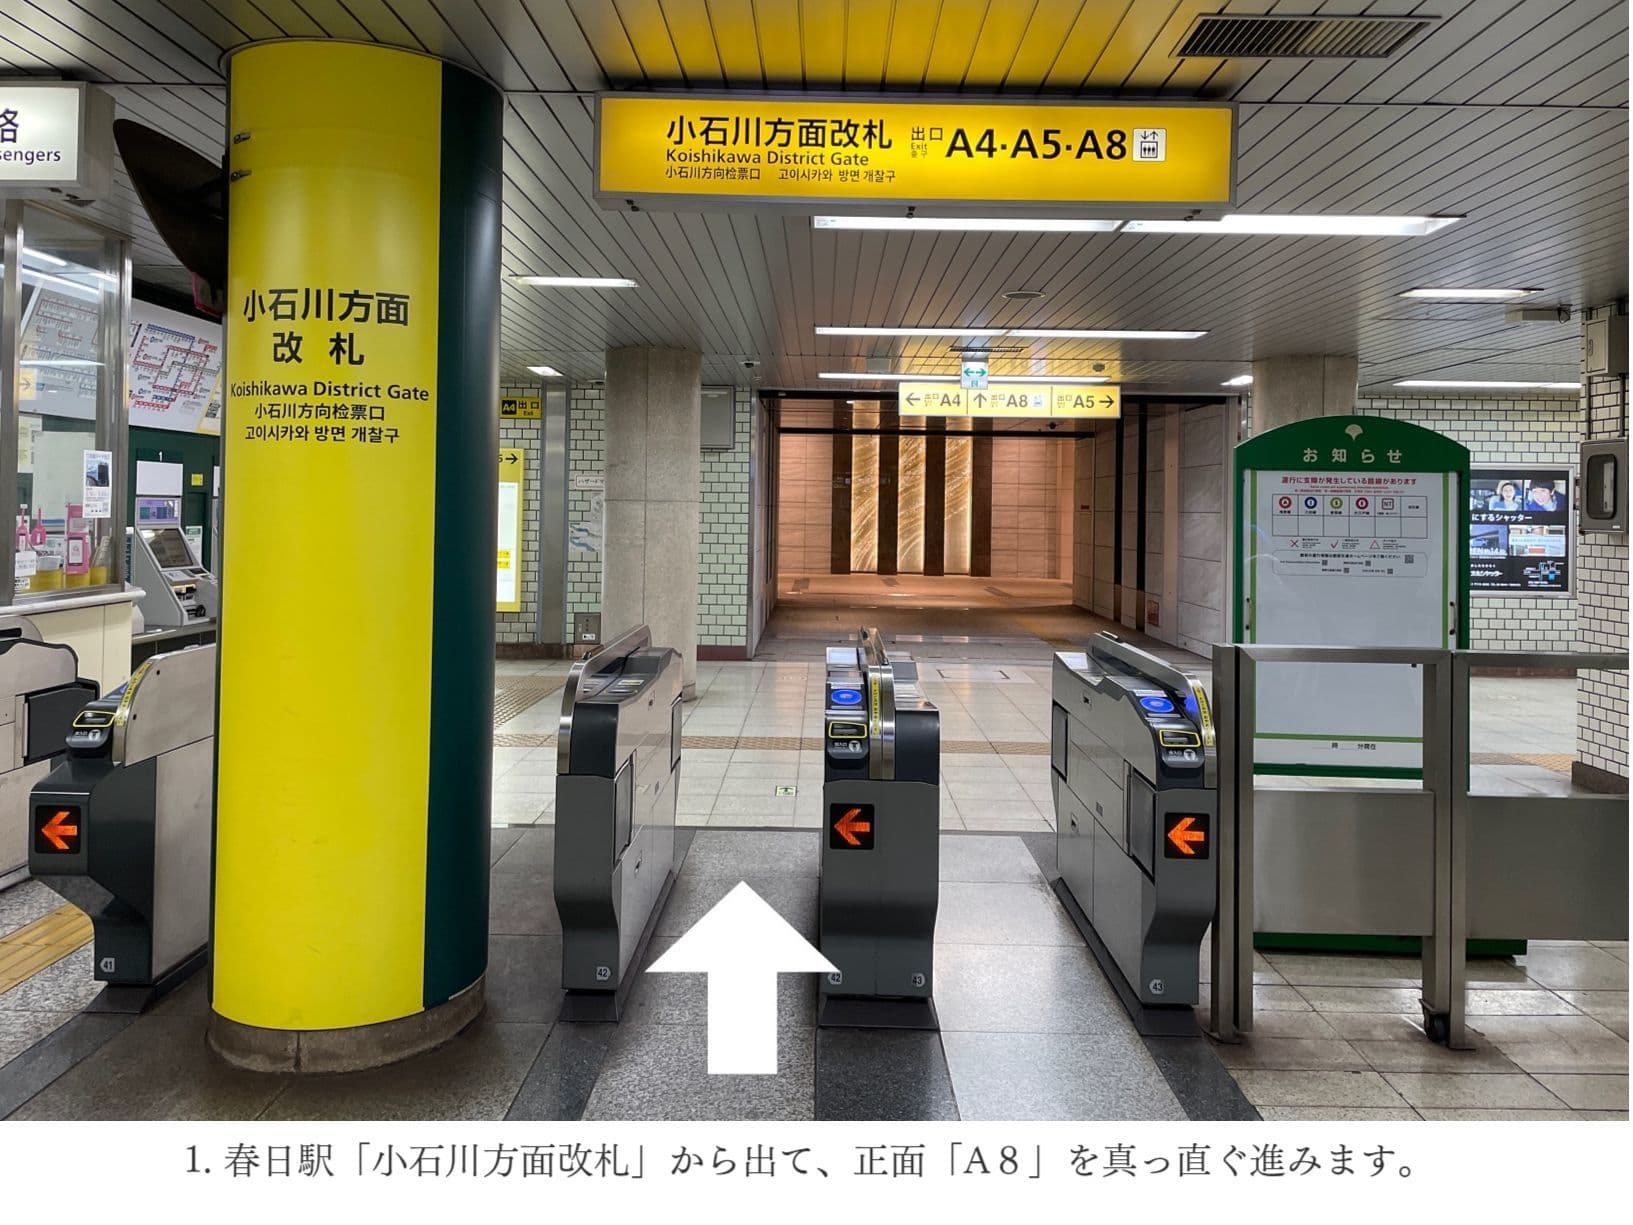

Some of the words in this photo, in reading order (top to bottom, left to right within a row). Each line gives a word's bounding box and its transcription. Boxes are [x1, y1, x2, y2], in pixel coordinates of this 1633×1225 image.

[666, 115, 893, 150] 小石川方面改札
[911, 125, 943, 141] 出口
[666, 149, 761, 165] Koishikawa
[767, 150, 825, 165] District
[830, 152, 869, 166] Gate
[665, 166, 761, 181] 小石川方向检票口
[778, 168, 833, 182] 고이시카와
[838, 170, 860, 183] 방면
[863, 170, 896, 183] 개찰구
[243, 287, 410, 327] 小石川方面
[272, 331, 365, 366] 改札
[230, 380, 308, 398] Koishikawa
[313, 381, 381, 399] District
[387, 385, 430, 402] Gate
[518, 400, 540, 409] 出口
[939, 393, 961, 407] A4
[1006, 395, 1028, 408] A8
[1072, 395, 1095, 408] A5
[254, 403, 385, 421] 小石川方向检票口
[503, 403, 516, 412] A4
[244, 425, 310, 442] 고이시카와
[314, 426, 346, 442] 방면
[351, 427, 400, 444] 개찰구
[158, 451, 163, 461] 1
[1302, 447, 1403, 464] お知らせ
[103, 960, 113, 970] 41
[598, 969, 609, 977] 42
[831, 973, 841, 983] 42
[912, 976, 922, 985] 43
[1152, 982, 1163, 992] 43
